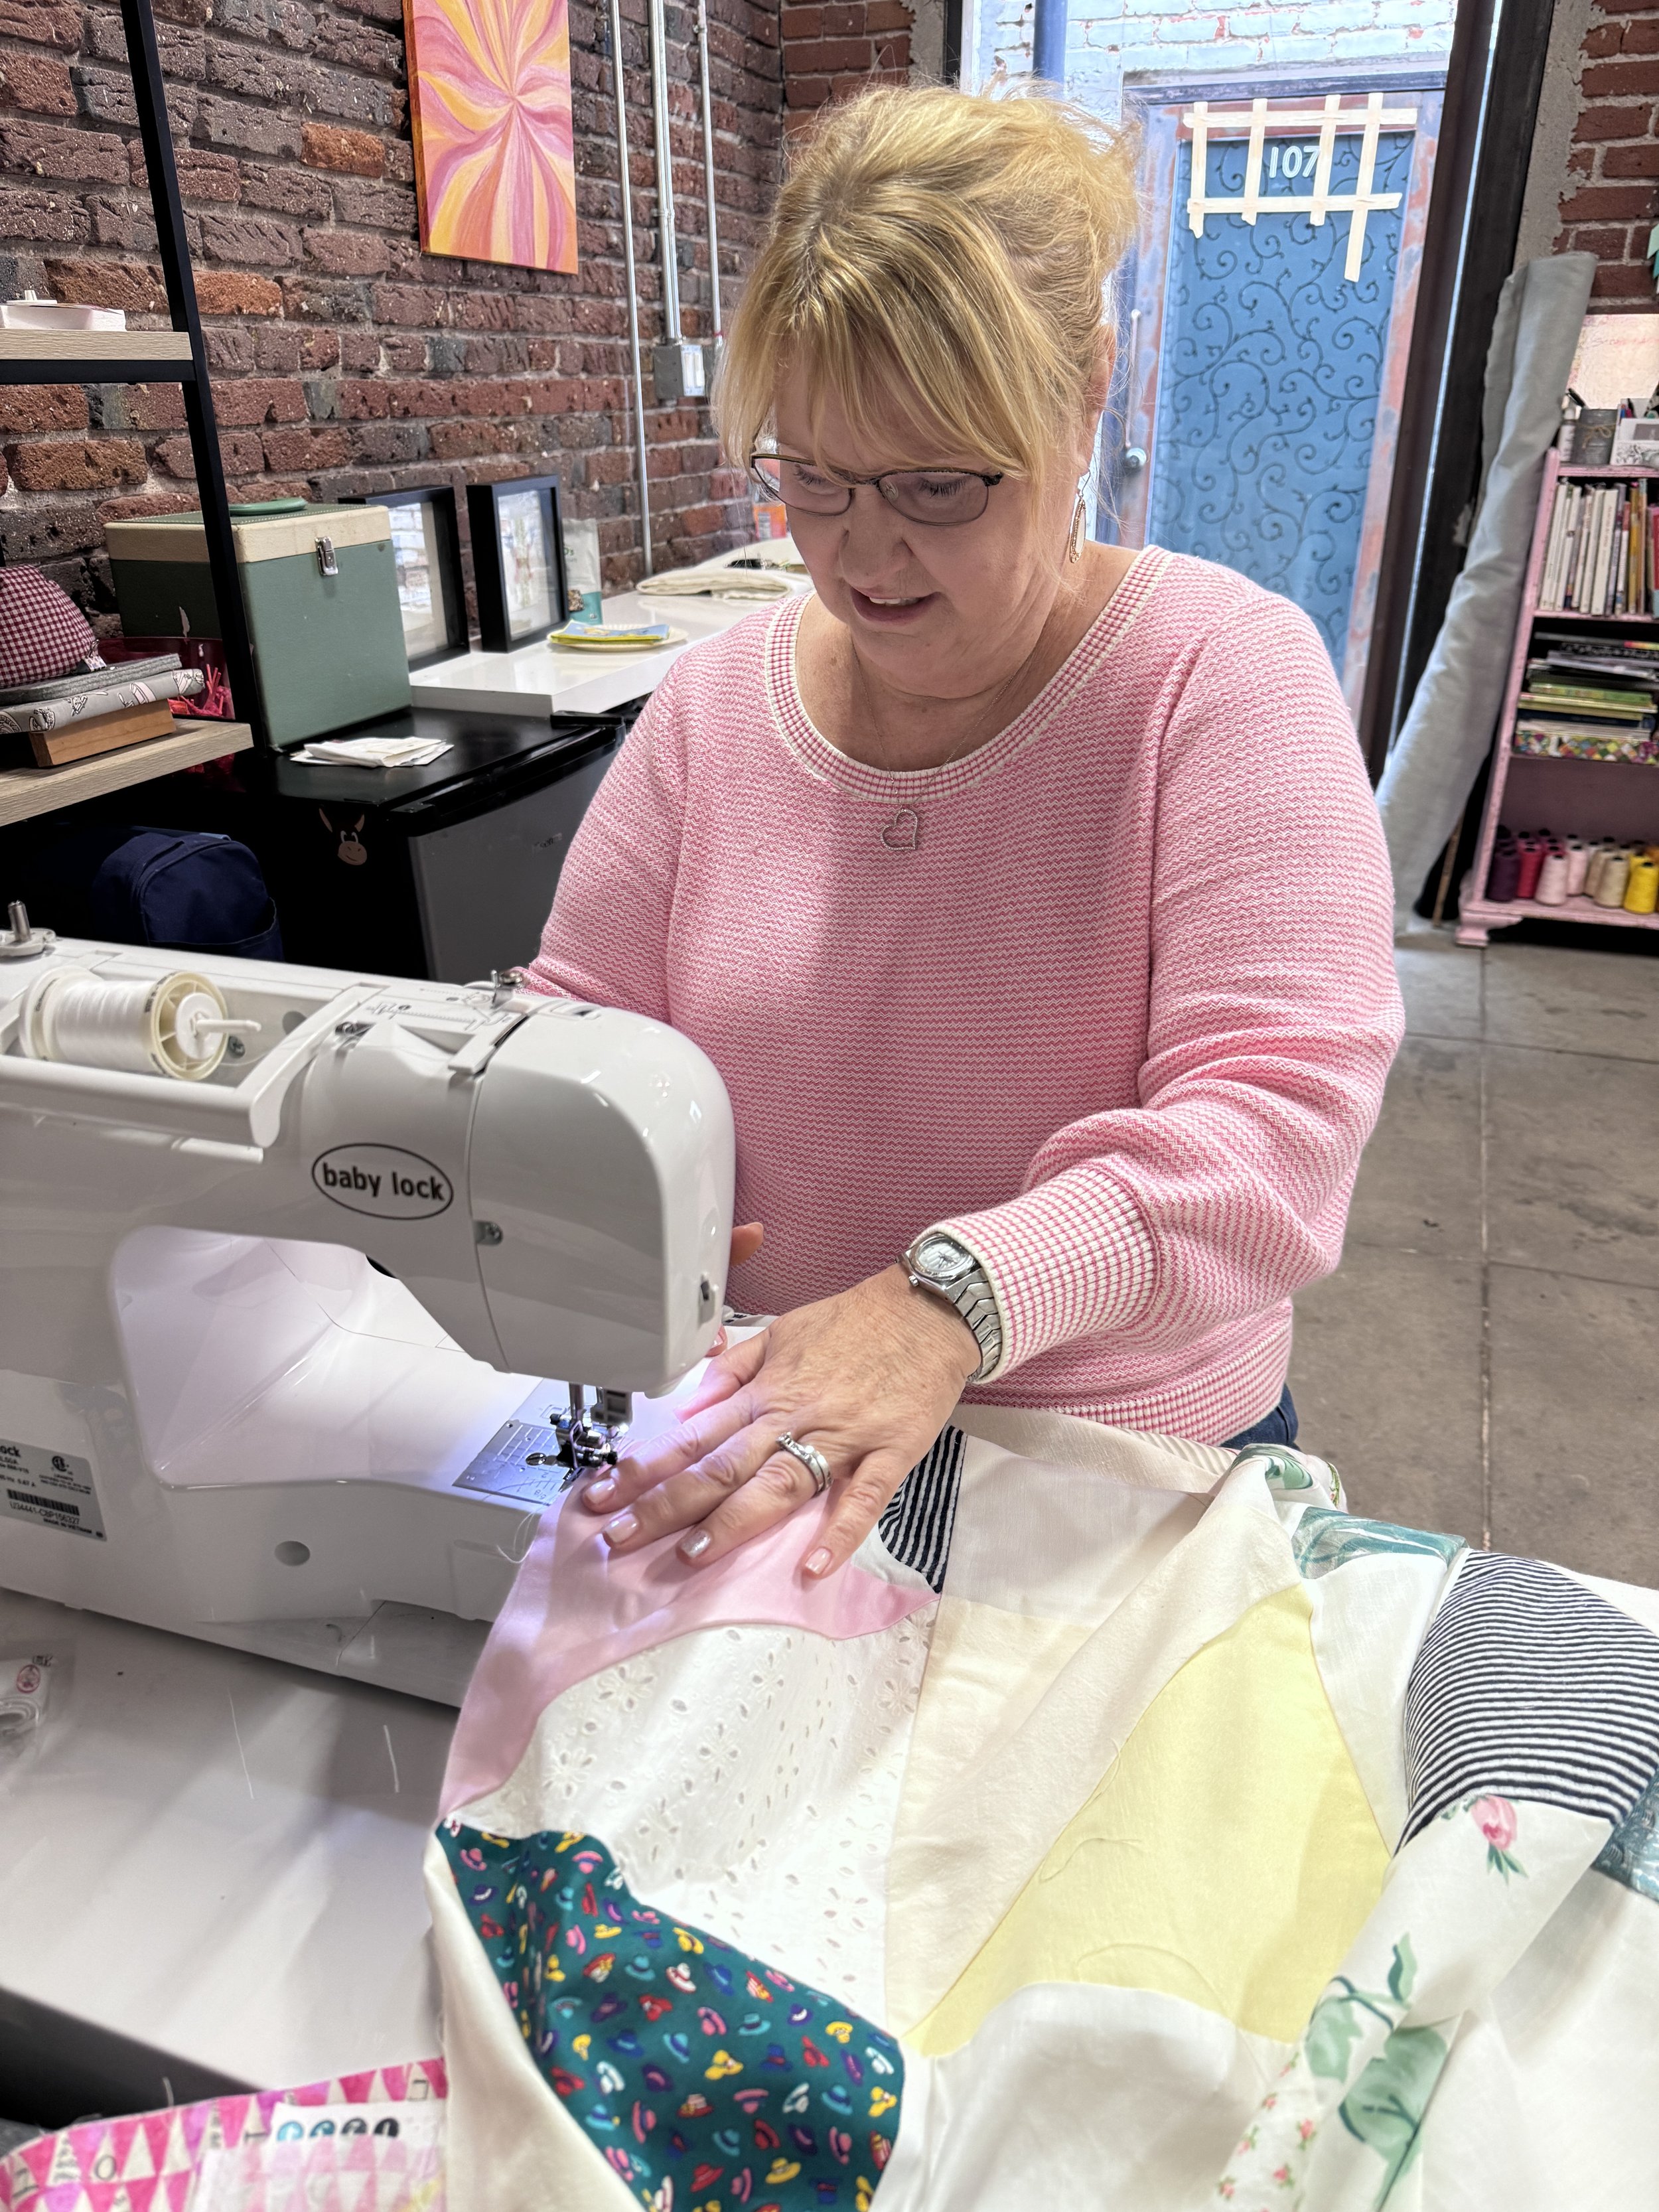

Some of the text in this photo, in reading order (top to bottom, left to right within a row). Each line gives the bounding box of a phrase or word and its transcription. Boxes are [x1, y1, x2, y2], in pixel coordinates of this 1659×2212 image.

[1269, 144, 1321, 179] 107
[323, 1162, 445, 1201] baby lock
[0, 1445, 21, 1457] ock
